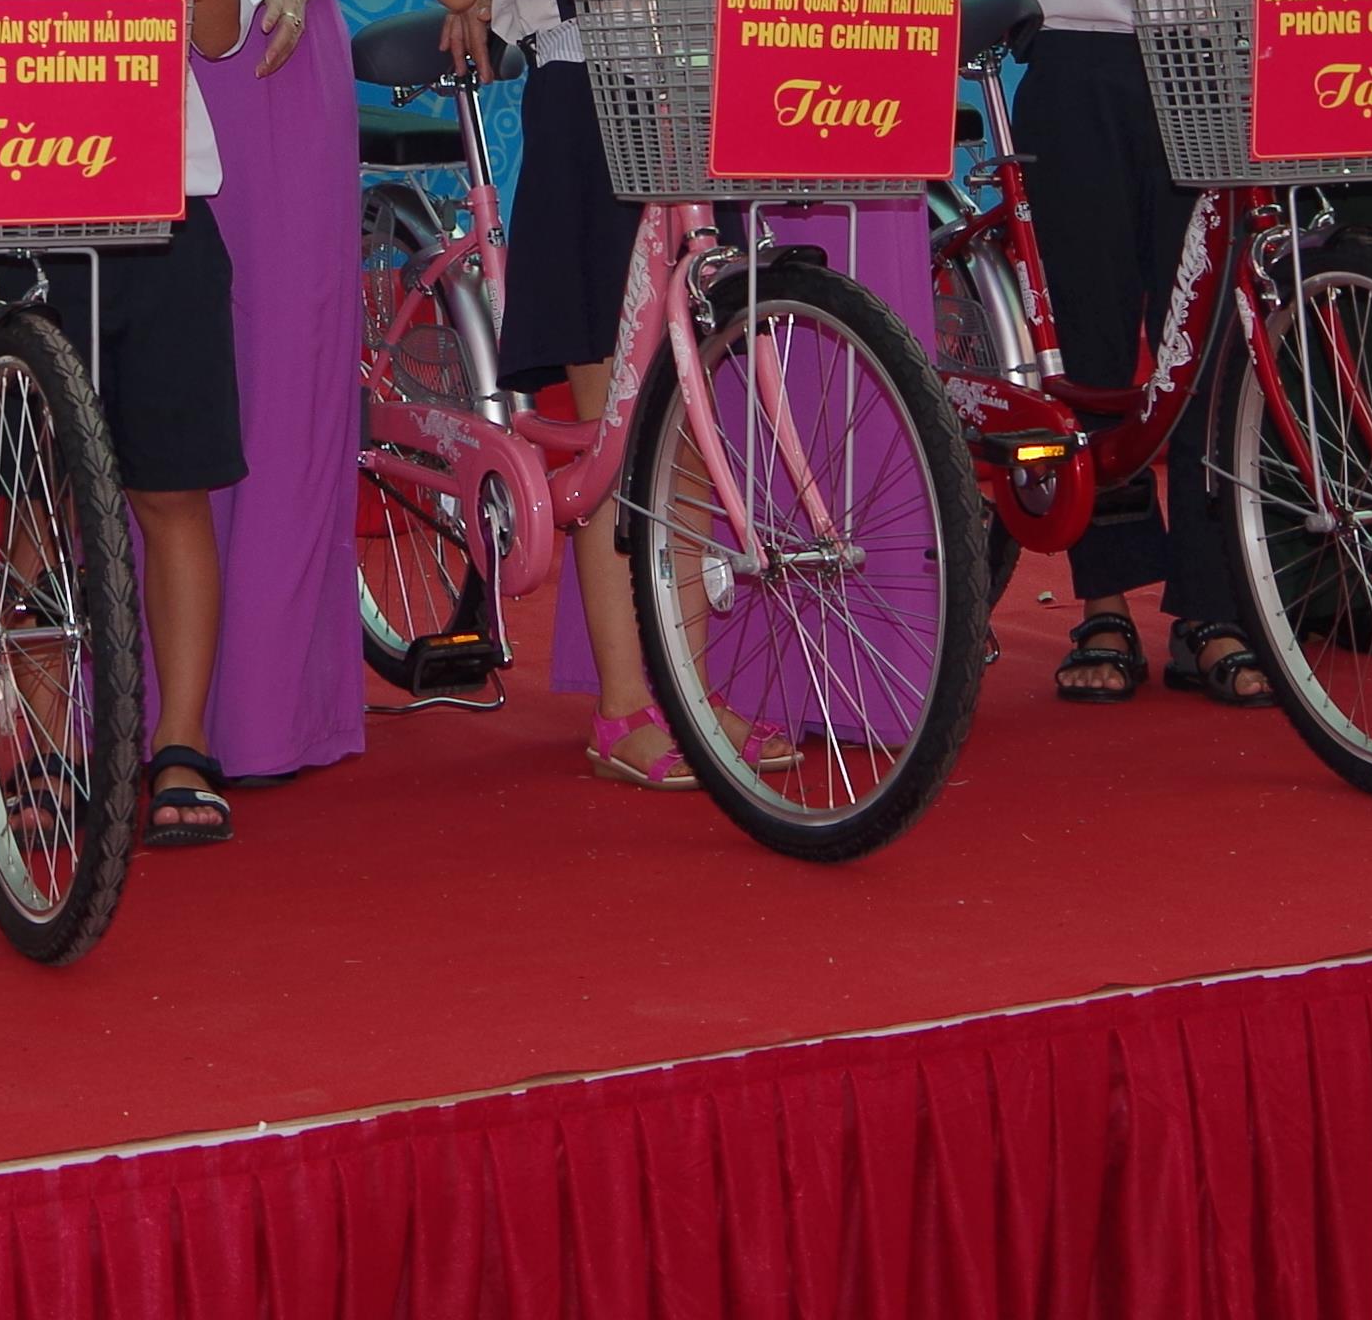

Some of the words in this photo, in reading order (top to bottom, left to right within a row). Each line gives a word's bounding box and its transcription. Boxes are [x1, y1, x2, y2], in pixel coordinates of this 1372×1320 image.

[27, 17, 52, 49] SỰ
[53, 11, 90, 43] TỈNH
[93, 9, 121, 43] HẢI
[123, 16, 177, 43] DƯƠNG
[740, 15, 825, 49] PHÒNG
[829, 19, 901, 51] CHÍNH
[905, 25, 940, 57] TRỊ
[1279, 5, 1362, 36] PHÒNG
[15, 50, 107, 84] CHÍNH
[114, 54, 159, 87] TRỊ
[773, 78, 902, 139] Tặng
